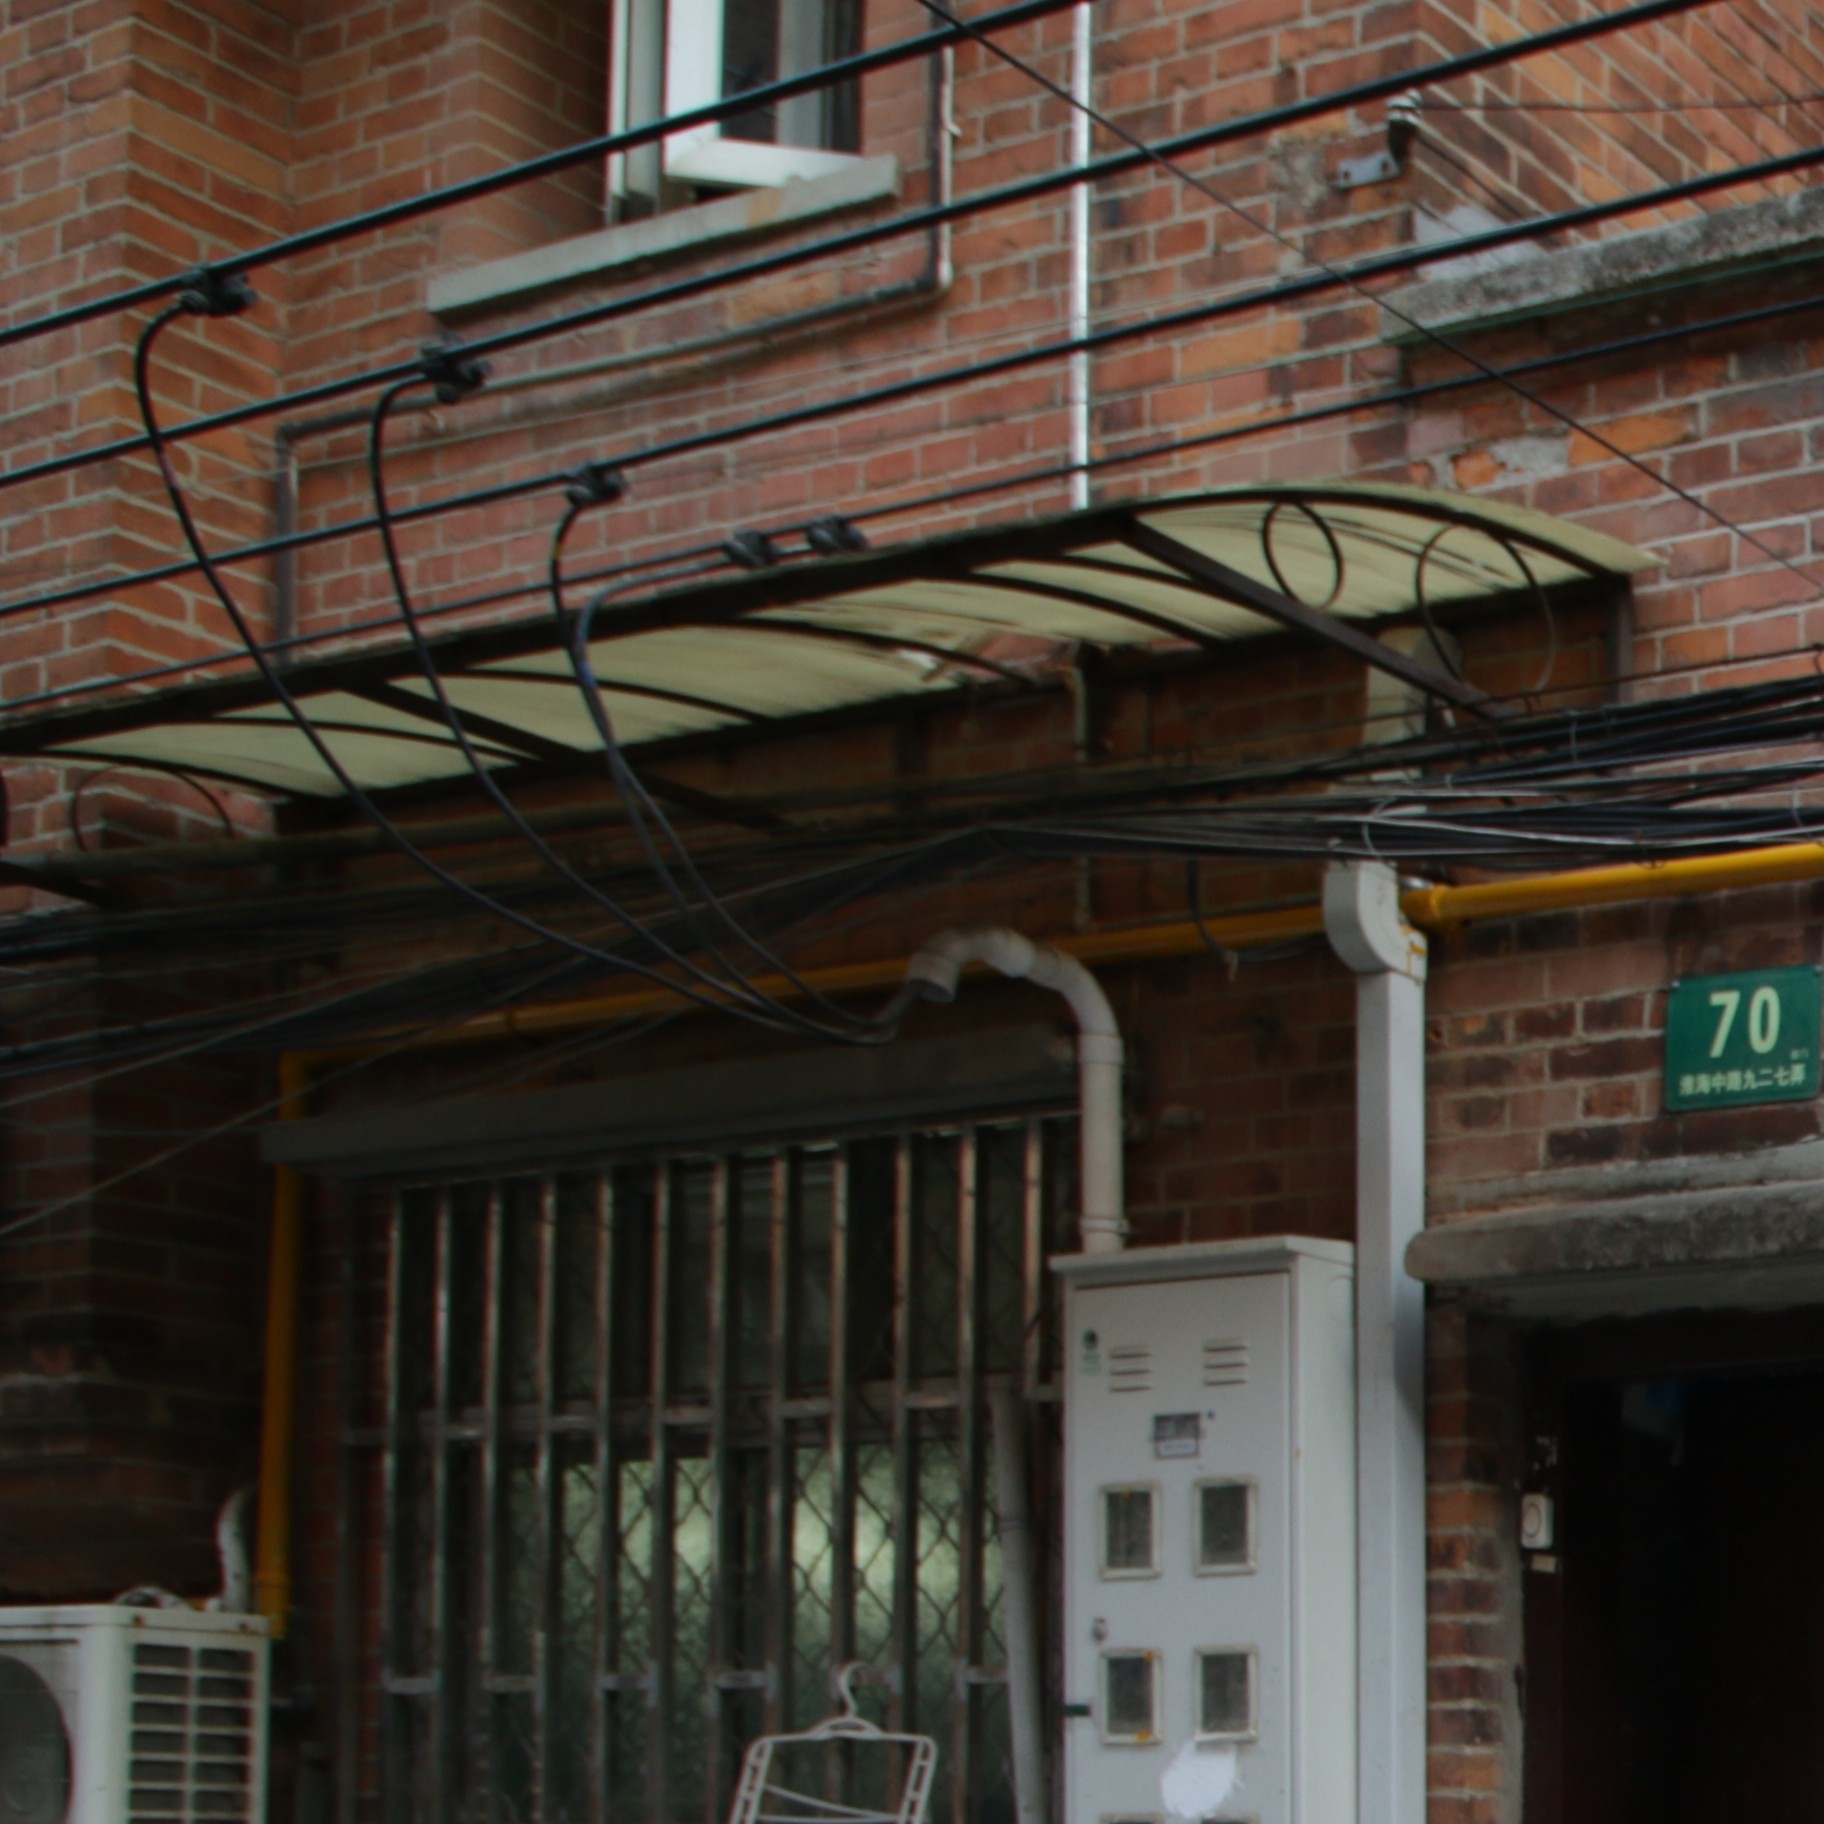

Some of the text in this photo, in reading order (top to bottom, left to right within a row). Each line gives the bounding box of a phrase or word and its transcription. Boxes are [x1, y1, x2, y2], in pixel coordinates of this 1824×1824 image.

[1708, 984, 1782, 1059] 70
[1678, 1062, 1807, 1097] 淮海中路九二七弄
